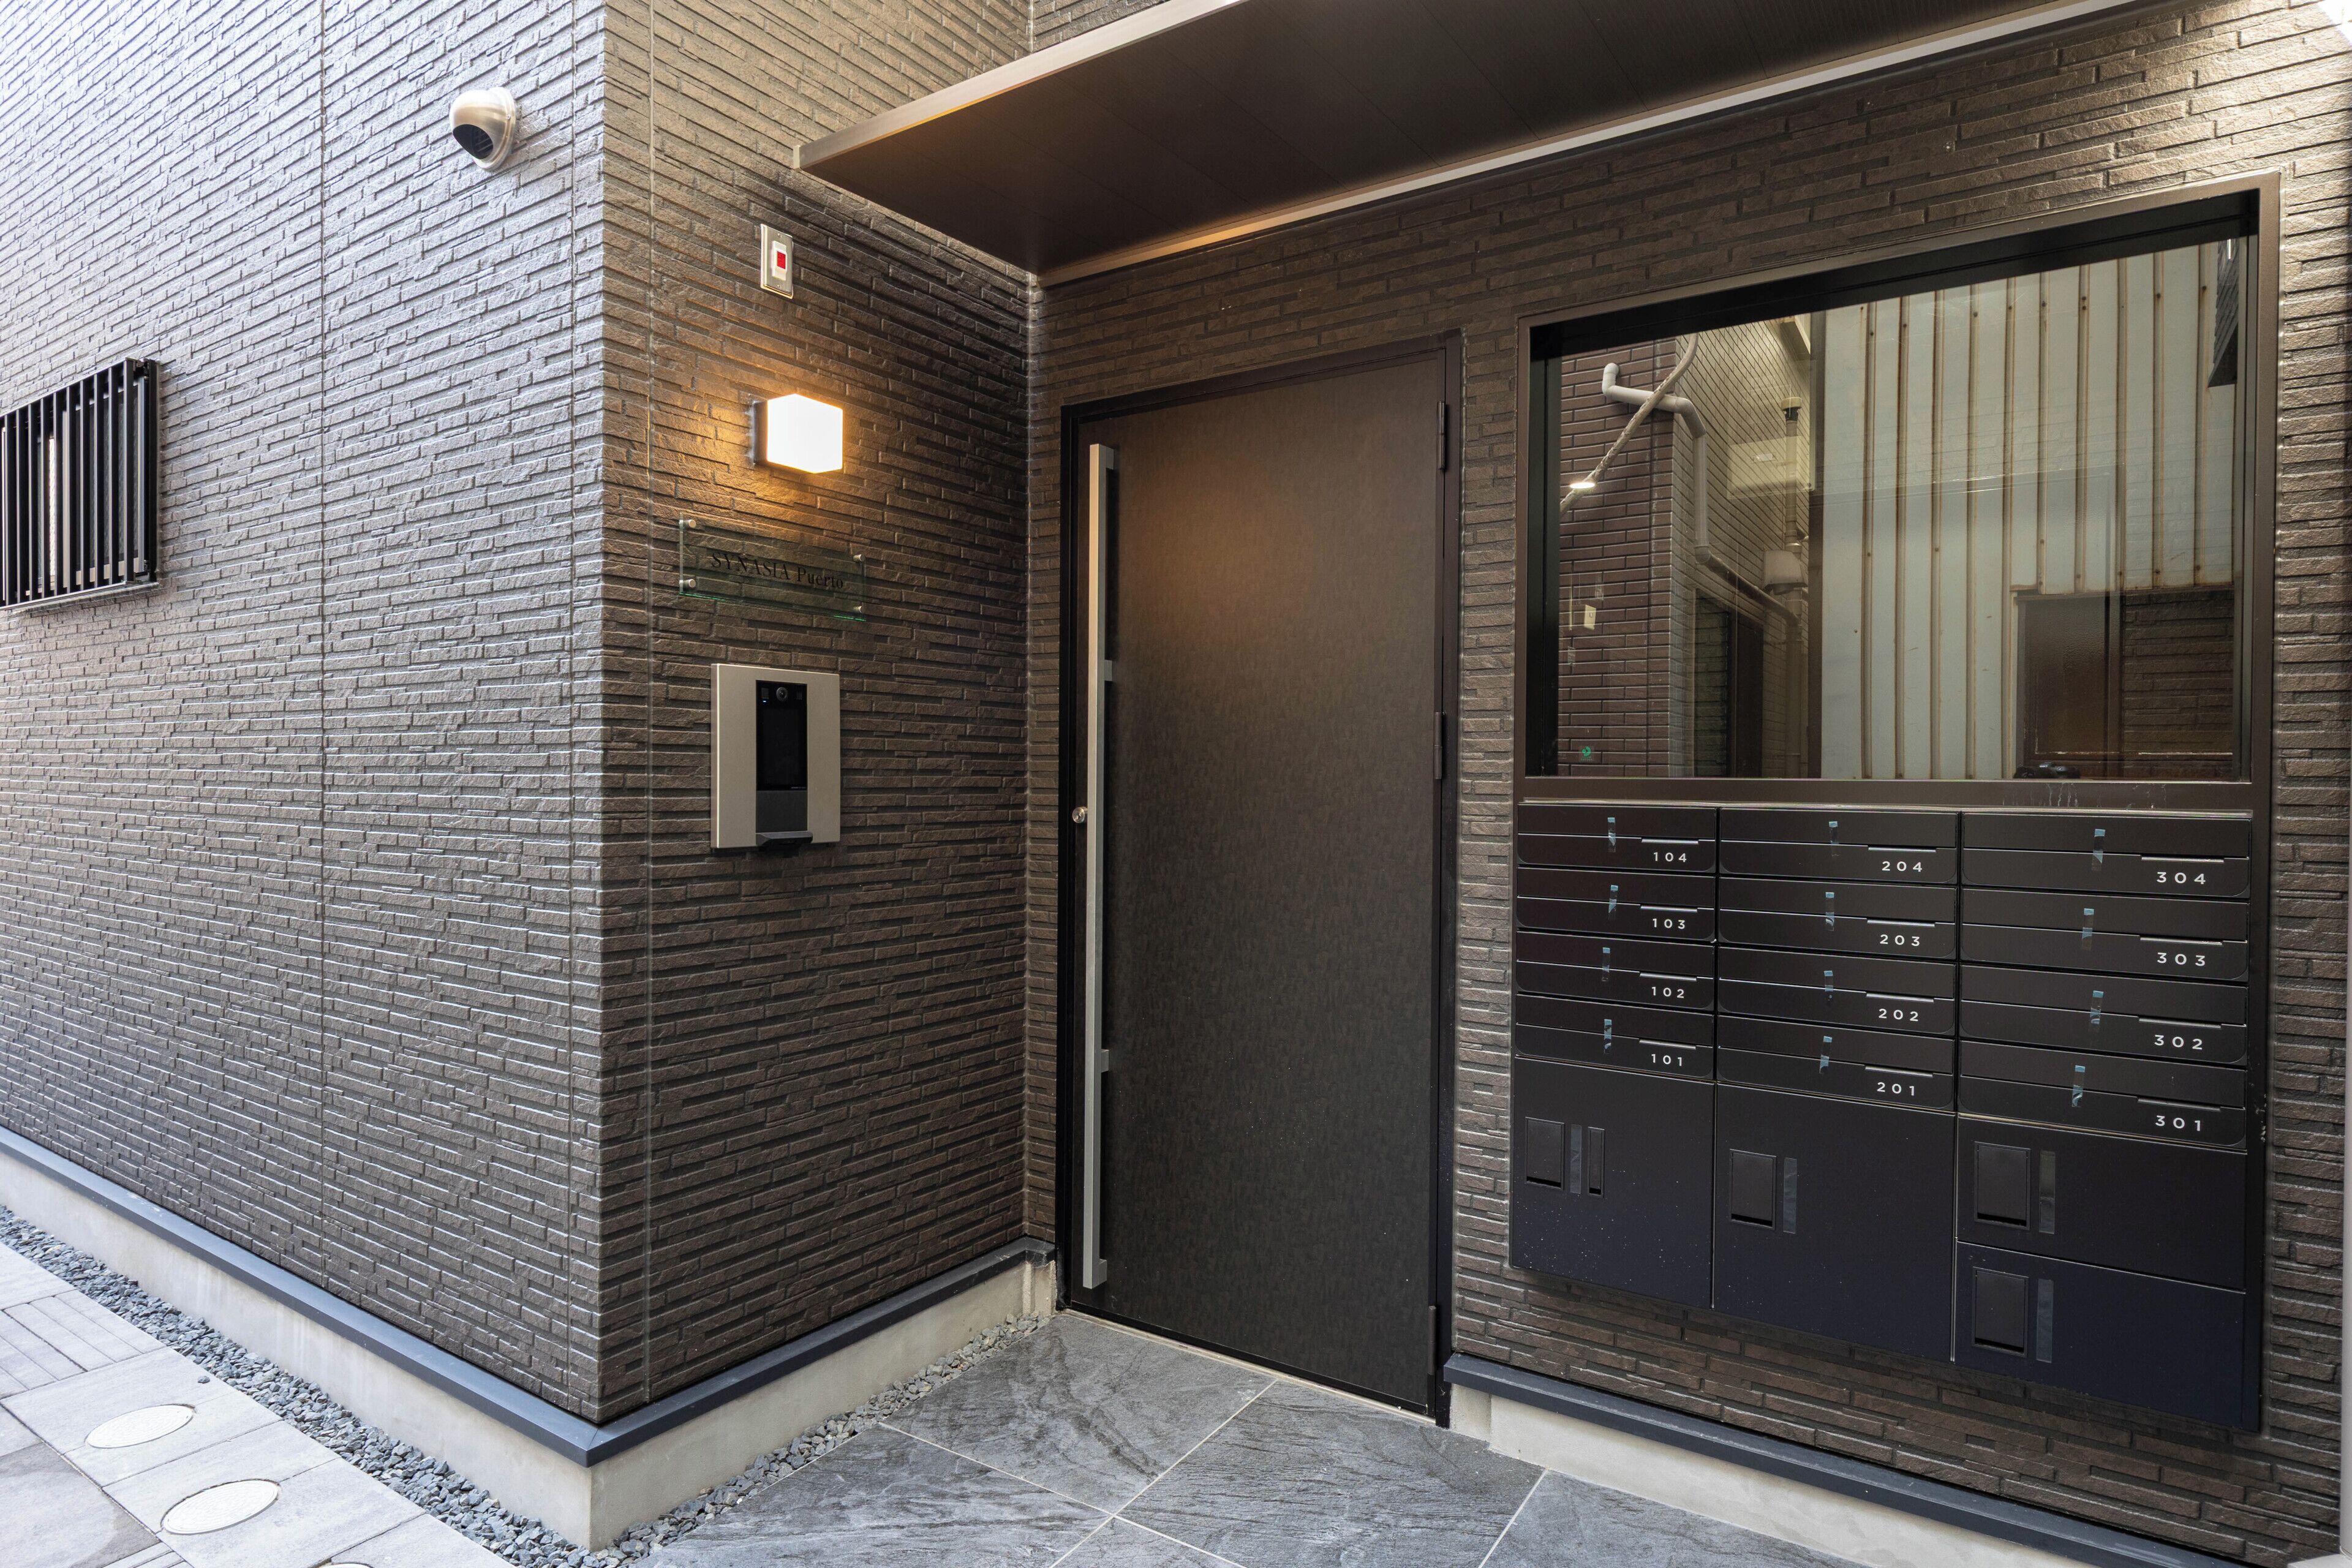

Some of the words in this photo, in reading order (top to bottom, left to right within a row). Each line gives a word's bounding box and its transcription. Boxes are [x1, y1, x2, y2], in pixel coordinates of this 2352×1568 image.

[712, 552, 791, 580] SYNASIA
[797, 567, 843, 589] Puerto
[1653, 851, 1687, 863] 104
[1882, 861, 1923, 872] 204
[2156, 872, 2206, 884] 304
[1653, 918, 1685, 930] 103
[1880, 934, 1920, 947] 203
[2157, 952, 2206, 967] 303
[1651, 986, 1684, 998] 102
[1878, 1008, 1918, 1022] 202
[2154, 1034, 2203, 1050] 302
[1651, 1054, 1683, 1066] 101
[1877, 1082, 1915, 1096] 201
[2155, 1115, 2201, 1131] 301
